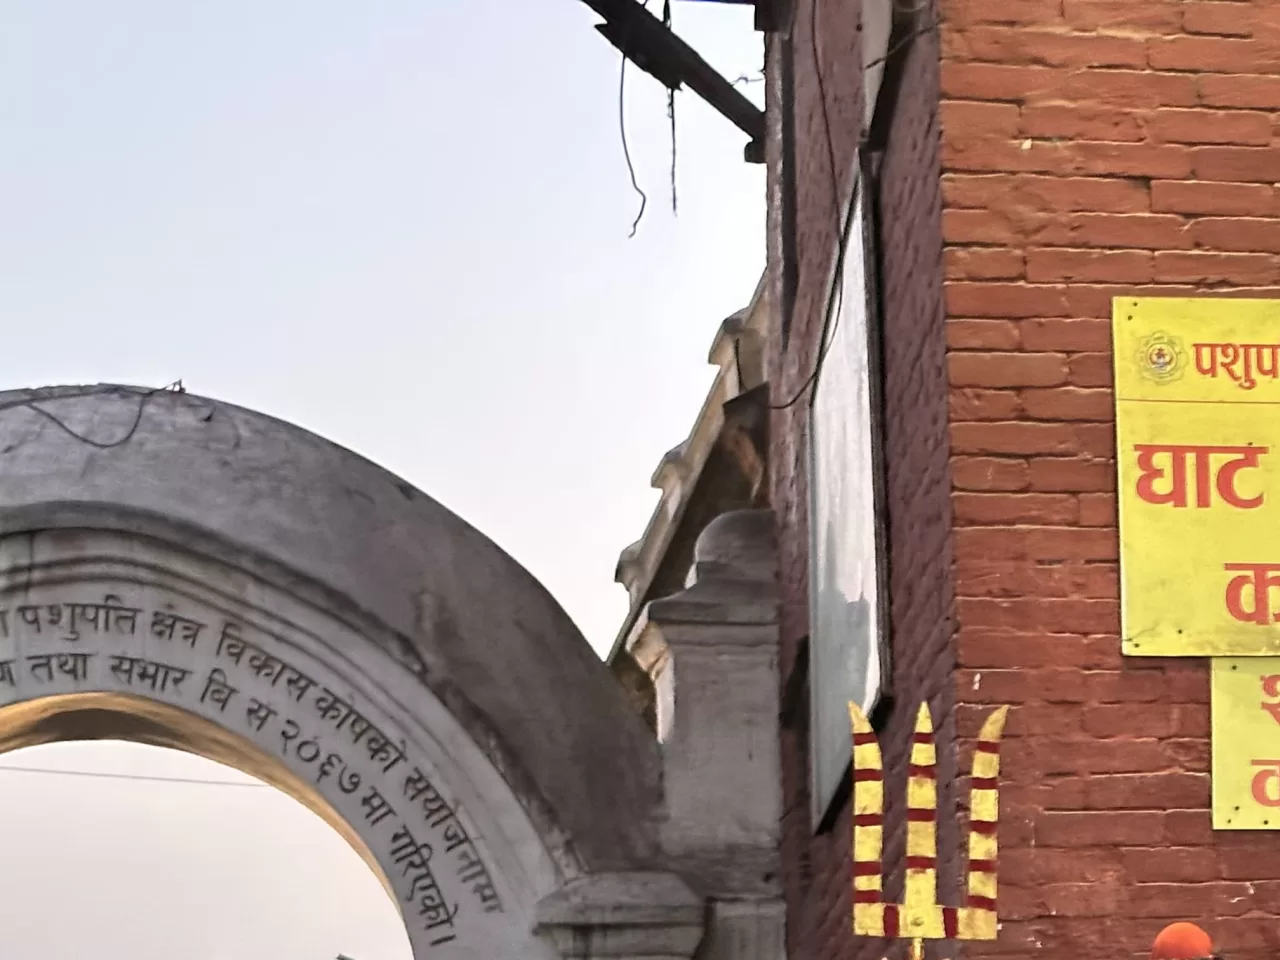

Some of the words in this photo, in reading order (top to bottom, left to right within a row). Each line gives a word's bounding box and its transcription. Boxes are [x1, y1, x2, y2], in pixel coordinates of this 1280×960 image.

[1134, 444, 1269, 510] घाट
[17, 594, 144, 642] पशुपति
[216, 621, 318, 702] विकास
[26, 652, 99, 682] तथा
[281, 719, 360, 795] २०६७
[361, 785, 397, 827] मा
